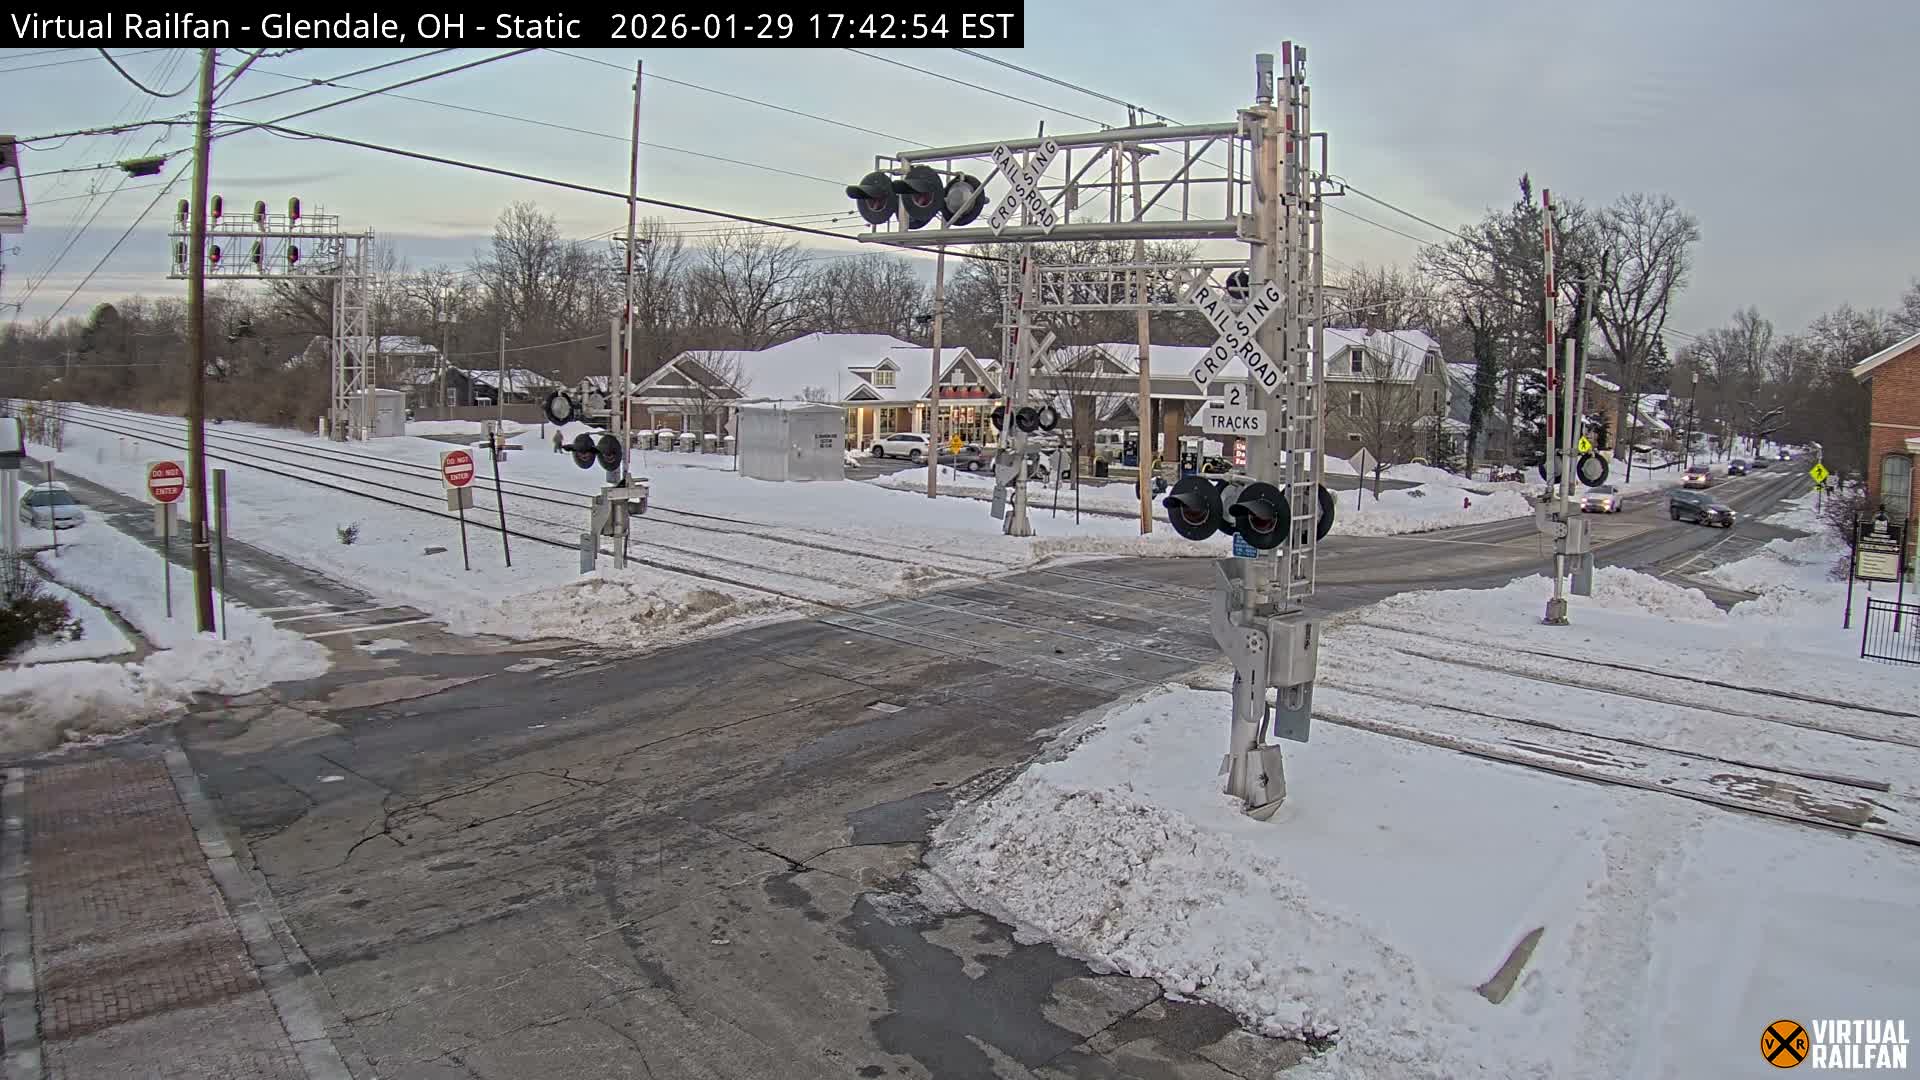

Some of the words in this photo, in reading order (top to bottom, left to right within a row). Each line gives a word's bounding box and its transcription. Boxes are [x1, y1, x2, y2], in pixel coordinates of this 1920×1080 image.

[991, 141, 1056, 229] CROSSING
[1194, 287, 1280, 385] CROSSING
[1230, 388, 1240, 405] 2
[1211, 415, 1259, 430] TRACKS
[457, 456, 468, 464] NOT
[165, 468, 178, 476] NOT
[155, 487, 177, 495] ENTER
